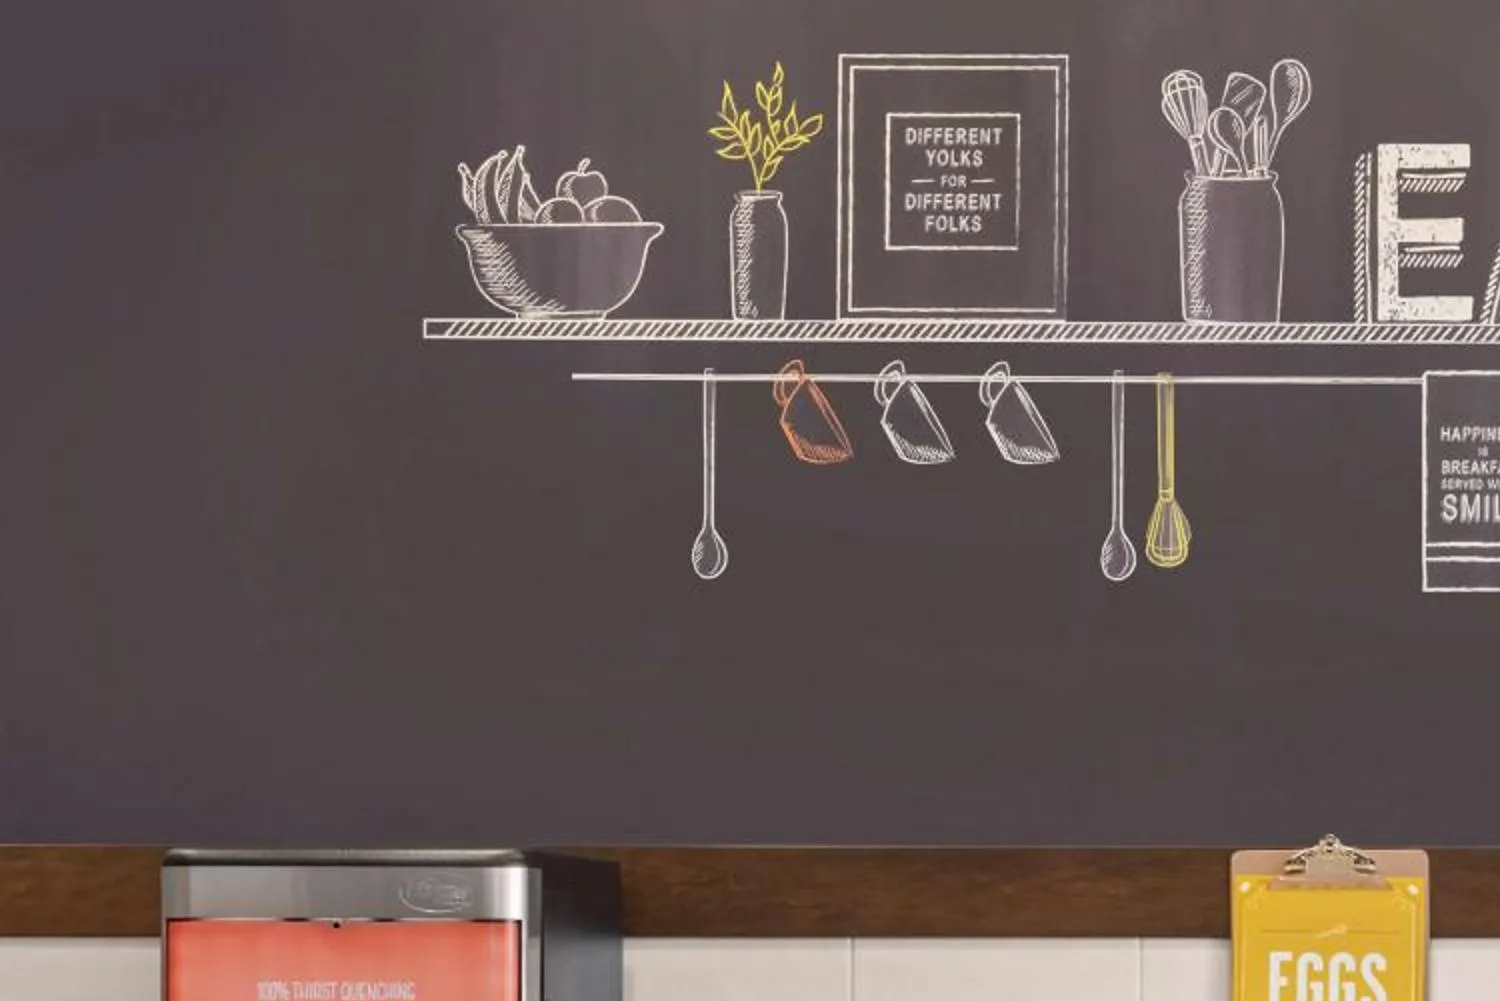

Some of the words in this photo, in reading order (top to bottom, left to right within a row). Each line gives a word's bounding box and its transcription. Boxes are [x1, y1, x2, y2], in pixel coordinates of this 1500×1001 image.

[905, 127, 1002, 145] DIFFERENT
[926, 150, 983, 167] YOLKS
[940, 175, 967, 187] FOR
[904, 193, 1002, 210] DIFFERENT
[925, 215, 982, 232] FOLKS
[1441, 479, 1484, 490] SERVED
[293, 981, 337, 1000] THIRST
[340, 981, 417, 1000] QUENCHING
